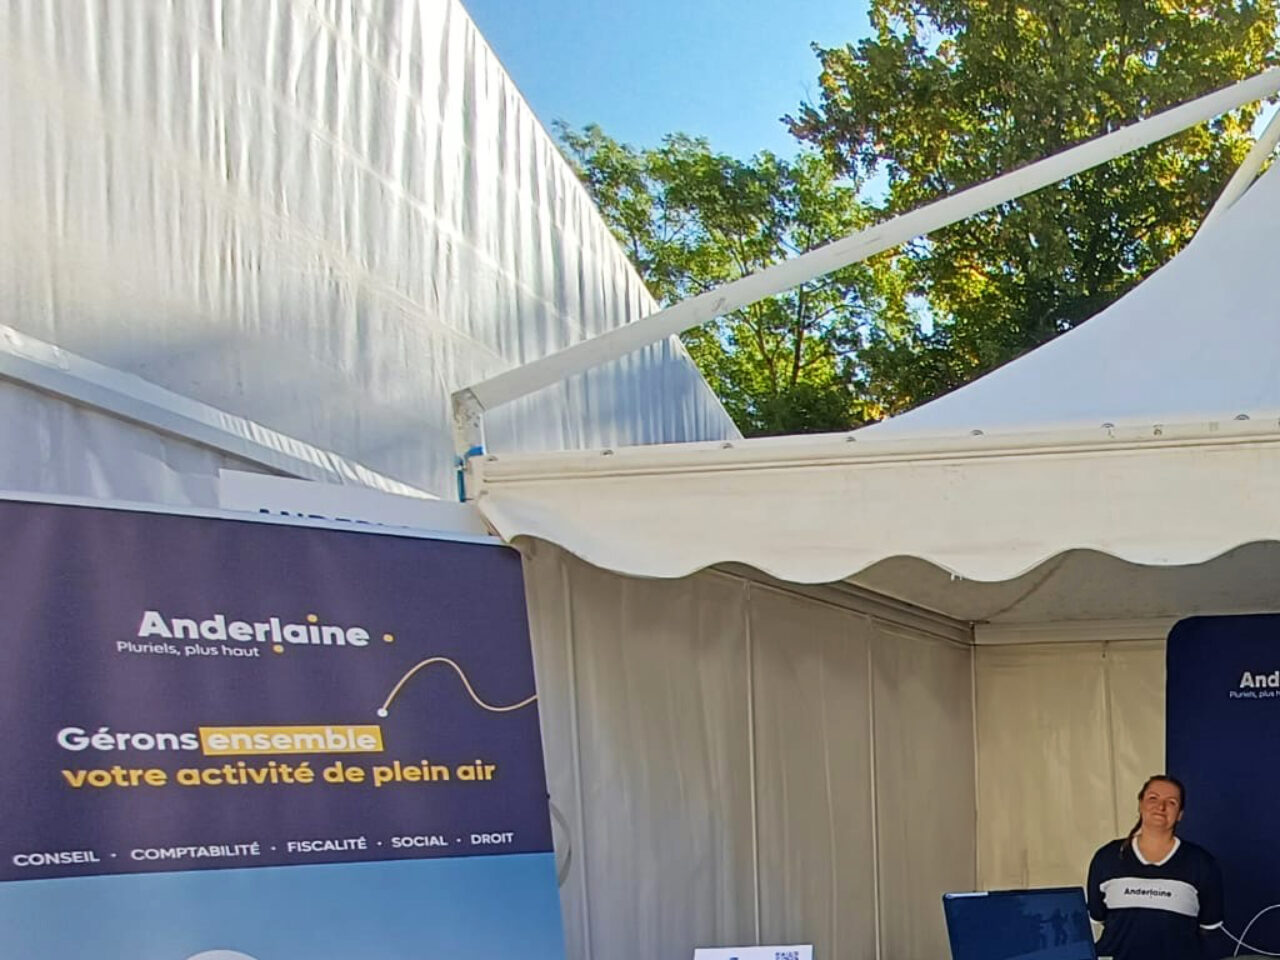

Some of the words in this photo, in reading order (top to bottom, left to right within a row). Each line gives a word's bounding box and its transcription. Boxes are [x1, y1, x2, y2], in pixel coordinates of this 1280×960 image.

[138, 611, 370, 648] Anderlaine
[116, 640, 181, 656] Pluriels,
[184, 643, 219, 656] plus
[222, 645, 260, 657] haut
[57, 727, 199, 752] Gérons
[207, 727, 377, 751] ensemble
[62, 765, 168, 788] votre
[177, 760, 315, 785] activité
[323, 761, 365, 784] de
[373, 759, 450, 787] plein
[457, 760, 496, 781] air
[13, 850, 100, 867] CONSEIL
[131, 841, 261, 861] COMPTABILITÉ
[287, 836, 368, 853] FISCALITÉ
[391, 835, 449, 848] SOCIAL
[470, 832, 514, 845] DROIT
